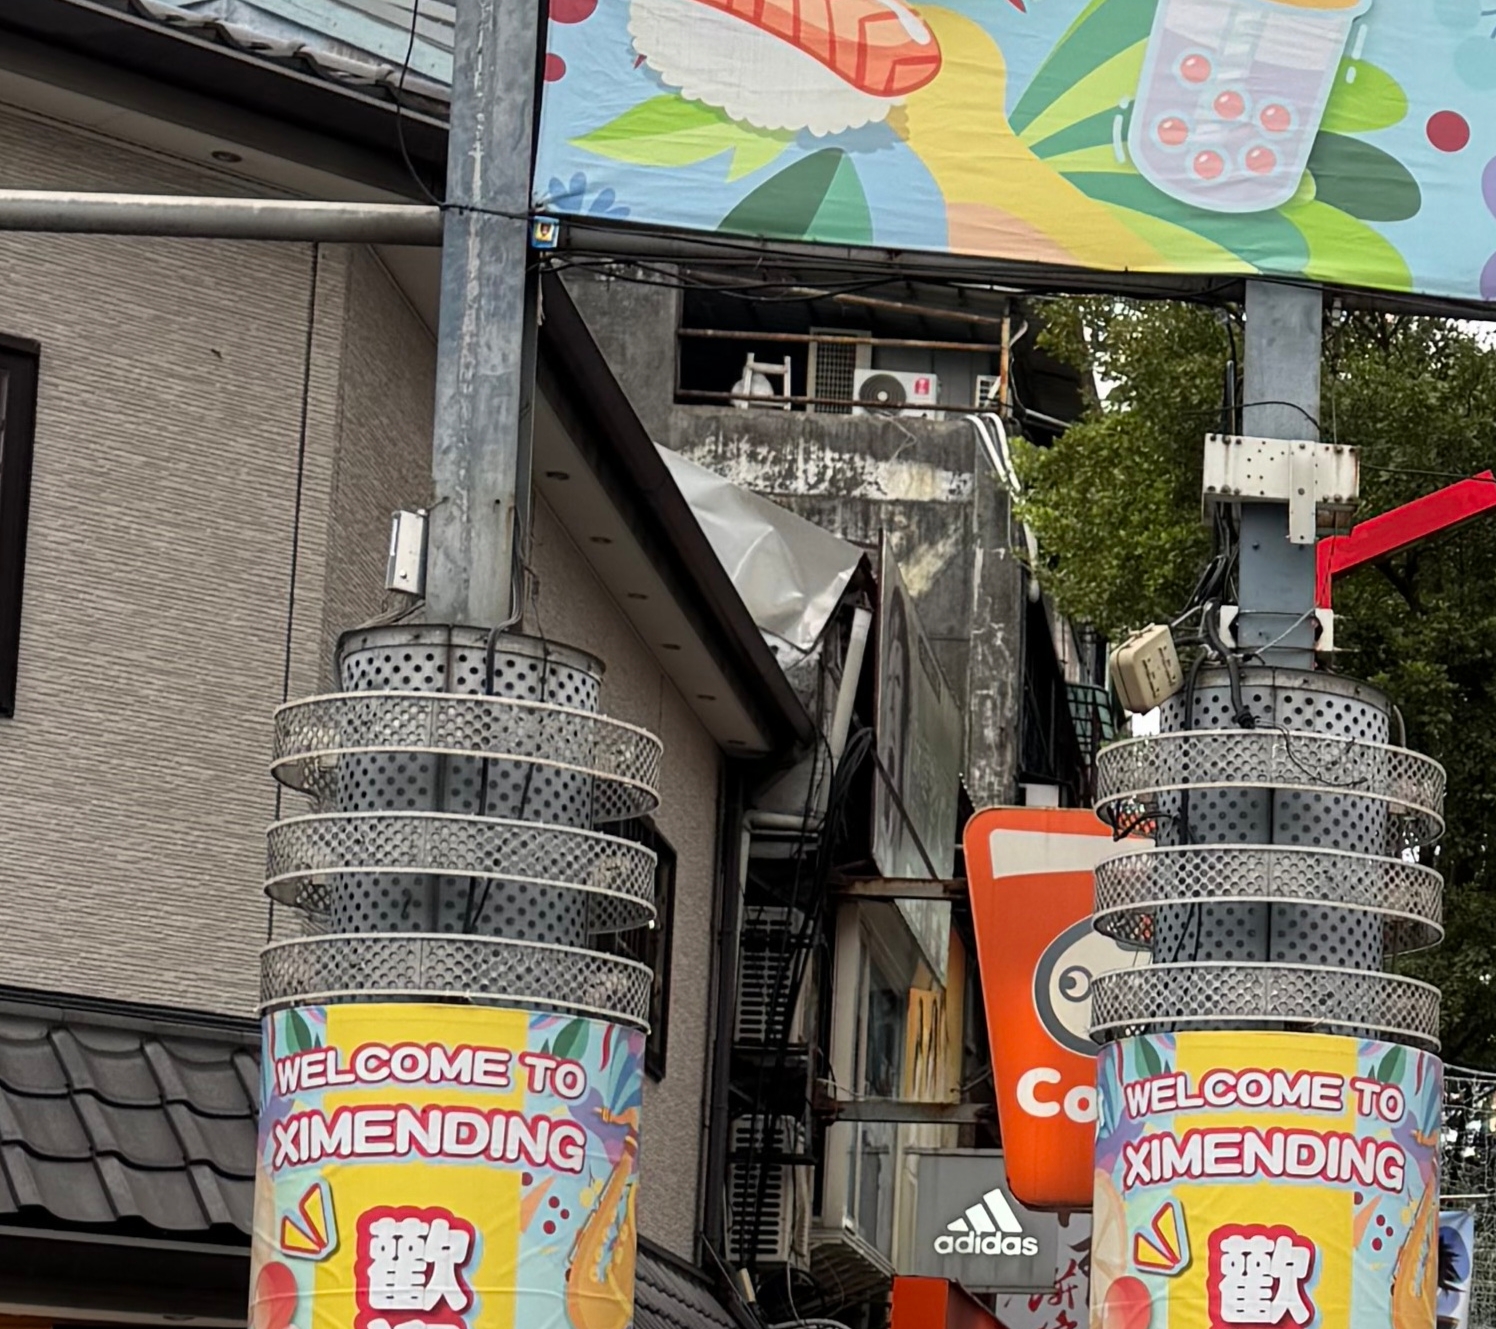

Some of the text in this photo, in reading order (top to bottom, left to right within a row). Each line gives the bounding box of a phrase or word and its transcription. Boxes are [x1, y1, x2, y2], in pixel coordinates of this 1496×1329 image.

[276, 1045, 586, 1098] WELCOME TO
[1125, 1071, 1405, 1121] WELCOME TO
[273, 1109, 588, 1173] XIMENDING
[1123, 1131, 1406, 1192] XIMENDING
[933, 1231, 1039, 1256] adidas
